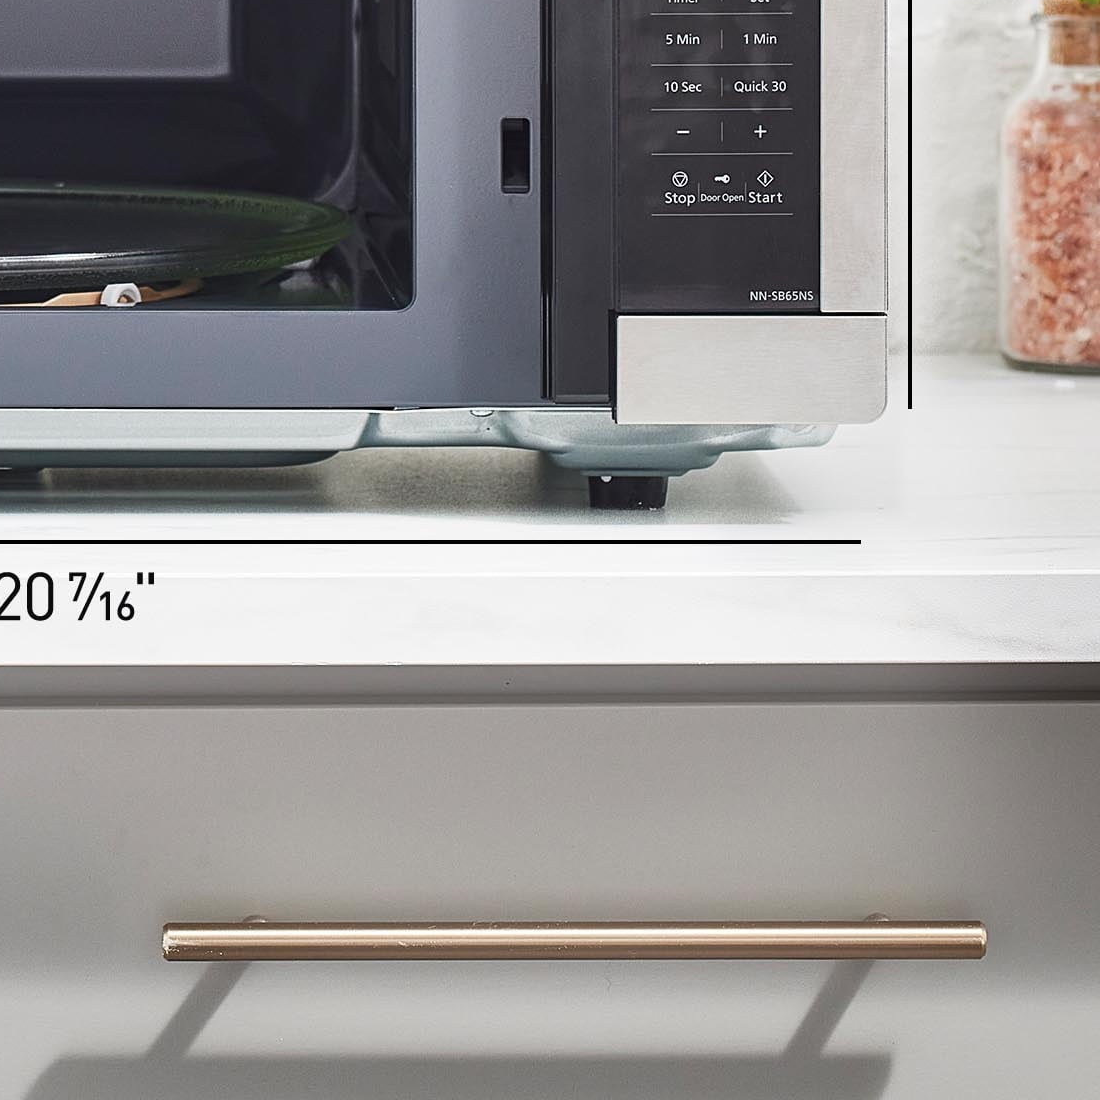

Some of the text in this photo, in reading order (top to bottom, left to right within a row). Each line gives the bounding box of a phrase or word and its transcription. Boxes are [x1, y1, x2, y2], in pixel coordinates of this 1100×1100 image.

[666, 34, 699, 44] 5 Min
[744, 33, 777, 44] 1 Min
[664, 82, 702, 92] 10 Sec
[734, 80, 786, 92] Quick 30
[665, 192, 695, 206] Stop
[722, 193, 744, 203] Open
[749, 192, 782, 203] Start
[750, 291, 813, 301] NN-SB65NS
